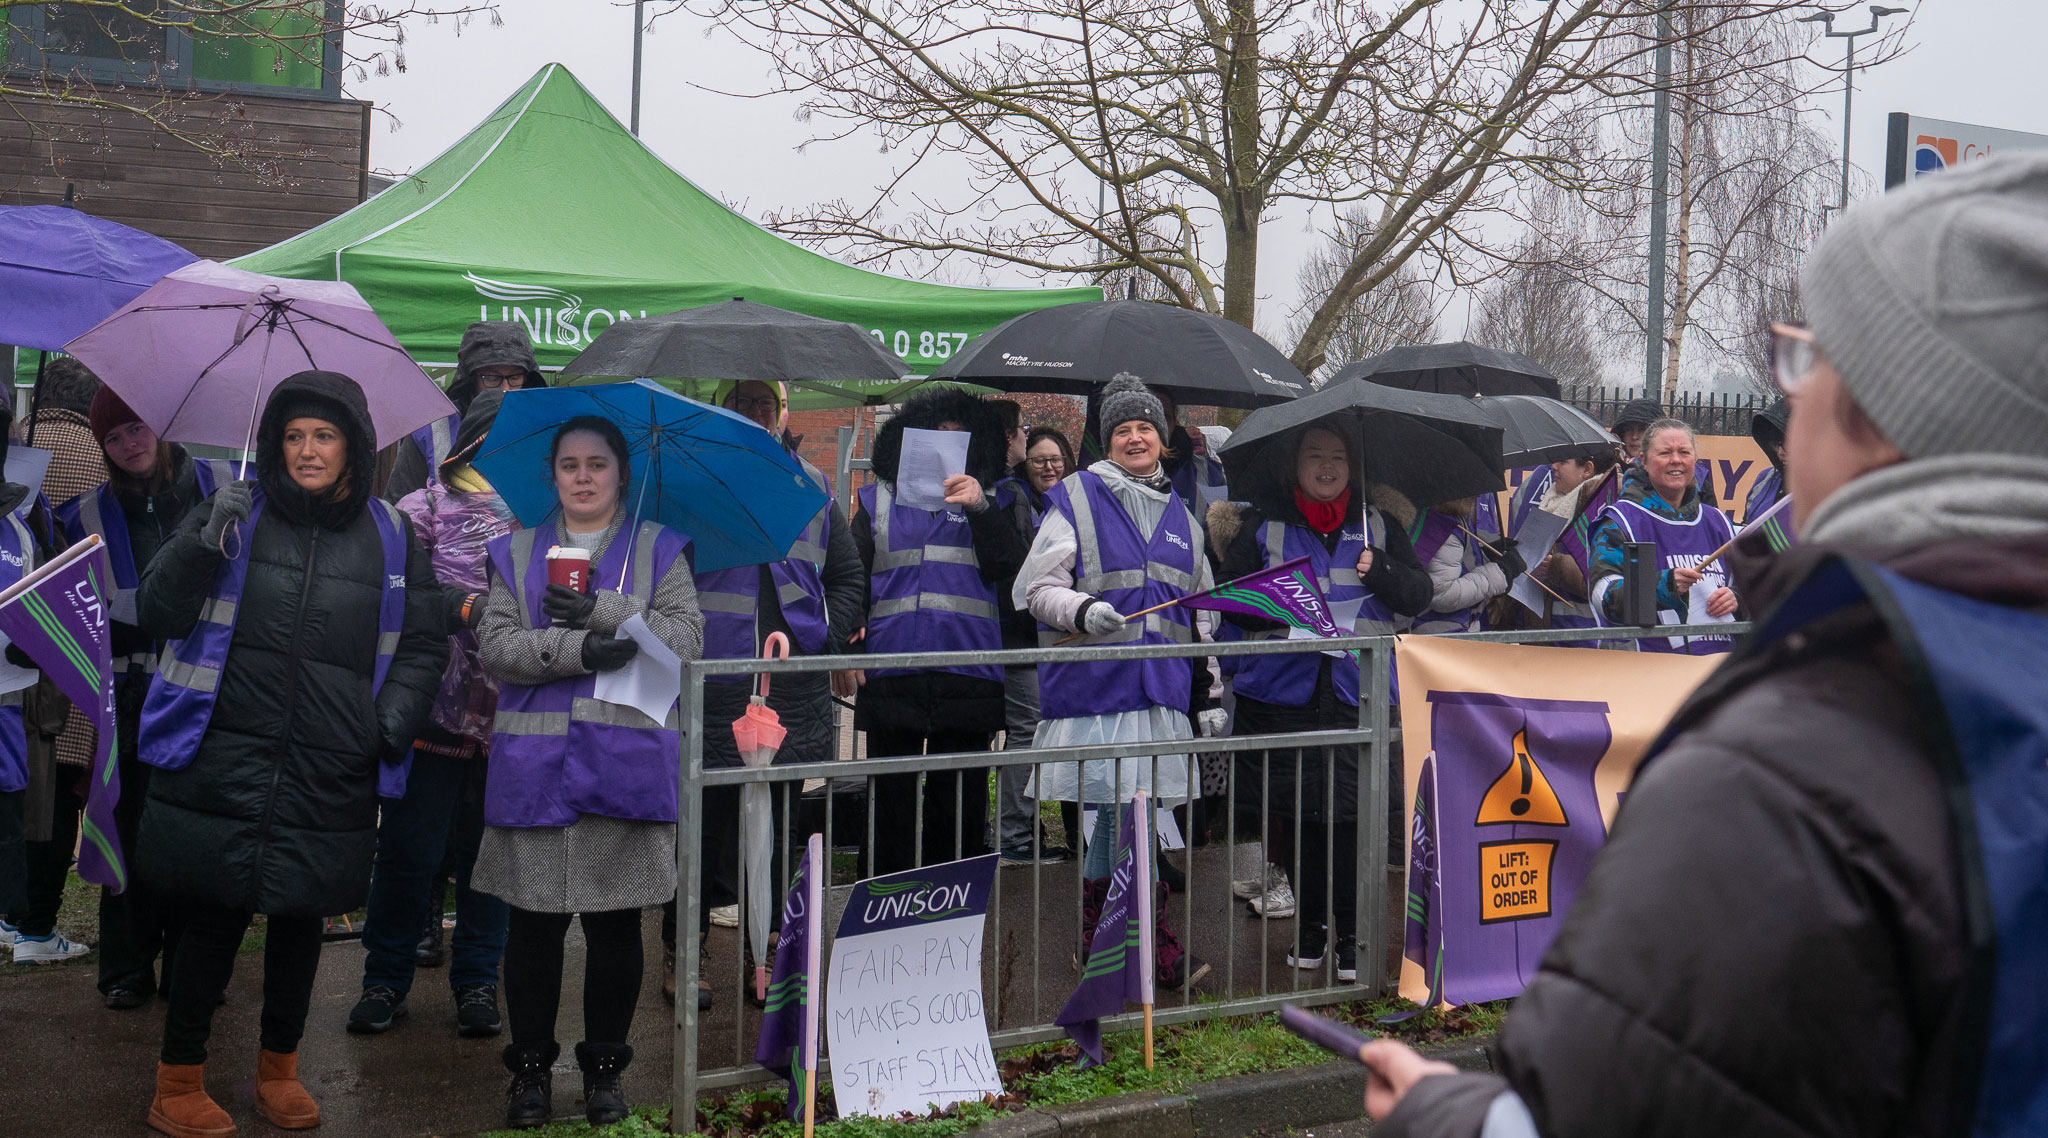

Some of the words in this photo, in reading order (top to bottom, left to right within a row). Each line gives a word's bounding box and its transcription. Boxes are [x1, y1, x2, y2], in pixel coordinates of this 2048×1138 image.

[918, 330, 968, 359] 857
[569, 570, 580, 592] STA
[64, 590, 78, 607] the
[1499, 851, 1529, 868] LIFT:
[1491, 871, 1517, 889] OUT
[1520, 869, 1538, 886] OF
[863, 882, 971, 924] UNISON
[1494, 889, 1537, 908] ORDER
[839, 944, 911, 994] FAIR
[924, 932, 976, 976] PAY
[835, 995, 921, 1043] MAKES
[928, 989, 981, 1024] GOOD
[843, 1056, 908, 1088] STAFF
[917, 1043, 995, 1087] STAY!
